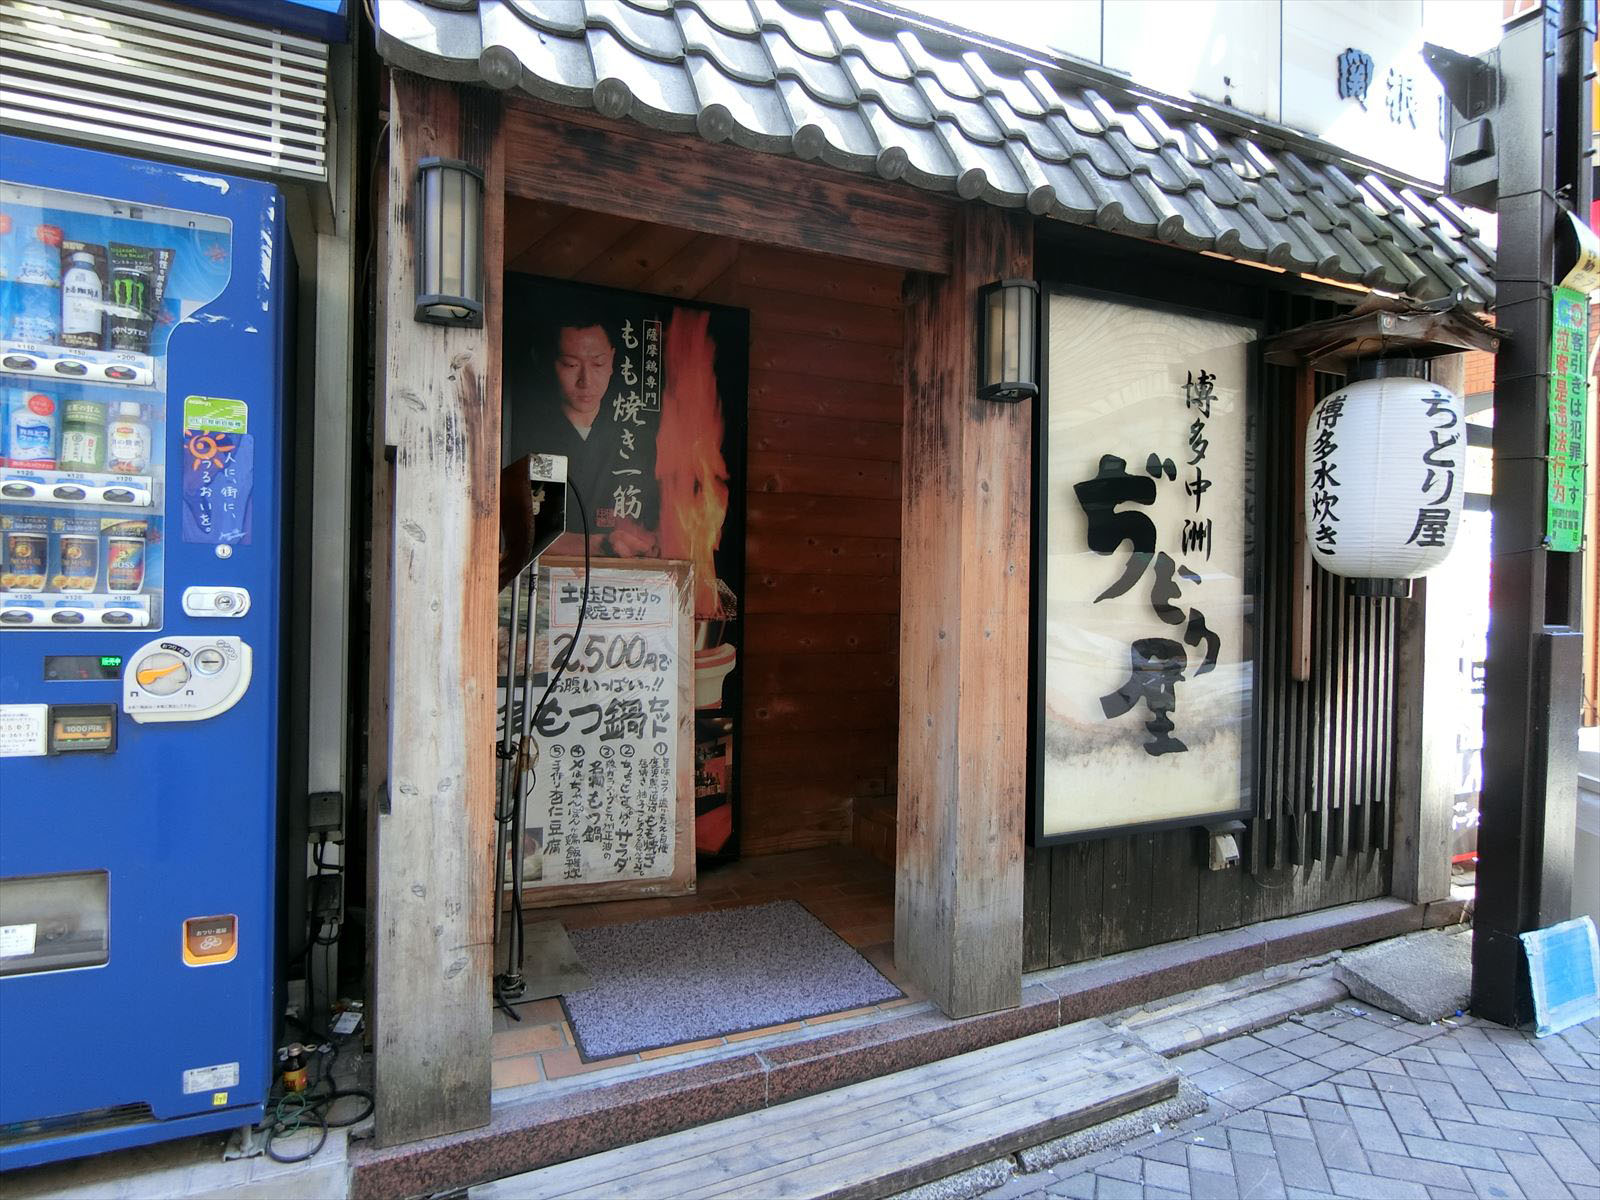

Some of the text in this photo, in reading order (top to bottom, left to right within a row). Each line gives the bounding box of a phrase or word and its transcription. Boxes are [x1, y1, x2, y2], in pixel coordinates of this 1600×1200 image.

[611, 319, 647, 519] もも焼き一筋
[1181, 370, 1219, 562] 博多中洲
[1311, 394, 1347, 555] 博多水炊き
[1568, 331, 1584, 505] 客引きは犯罪です
